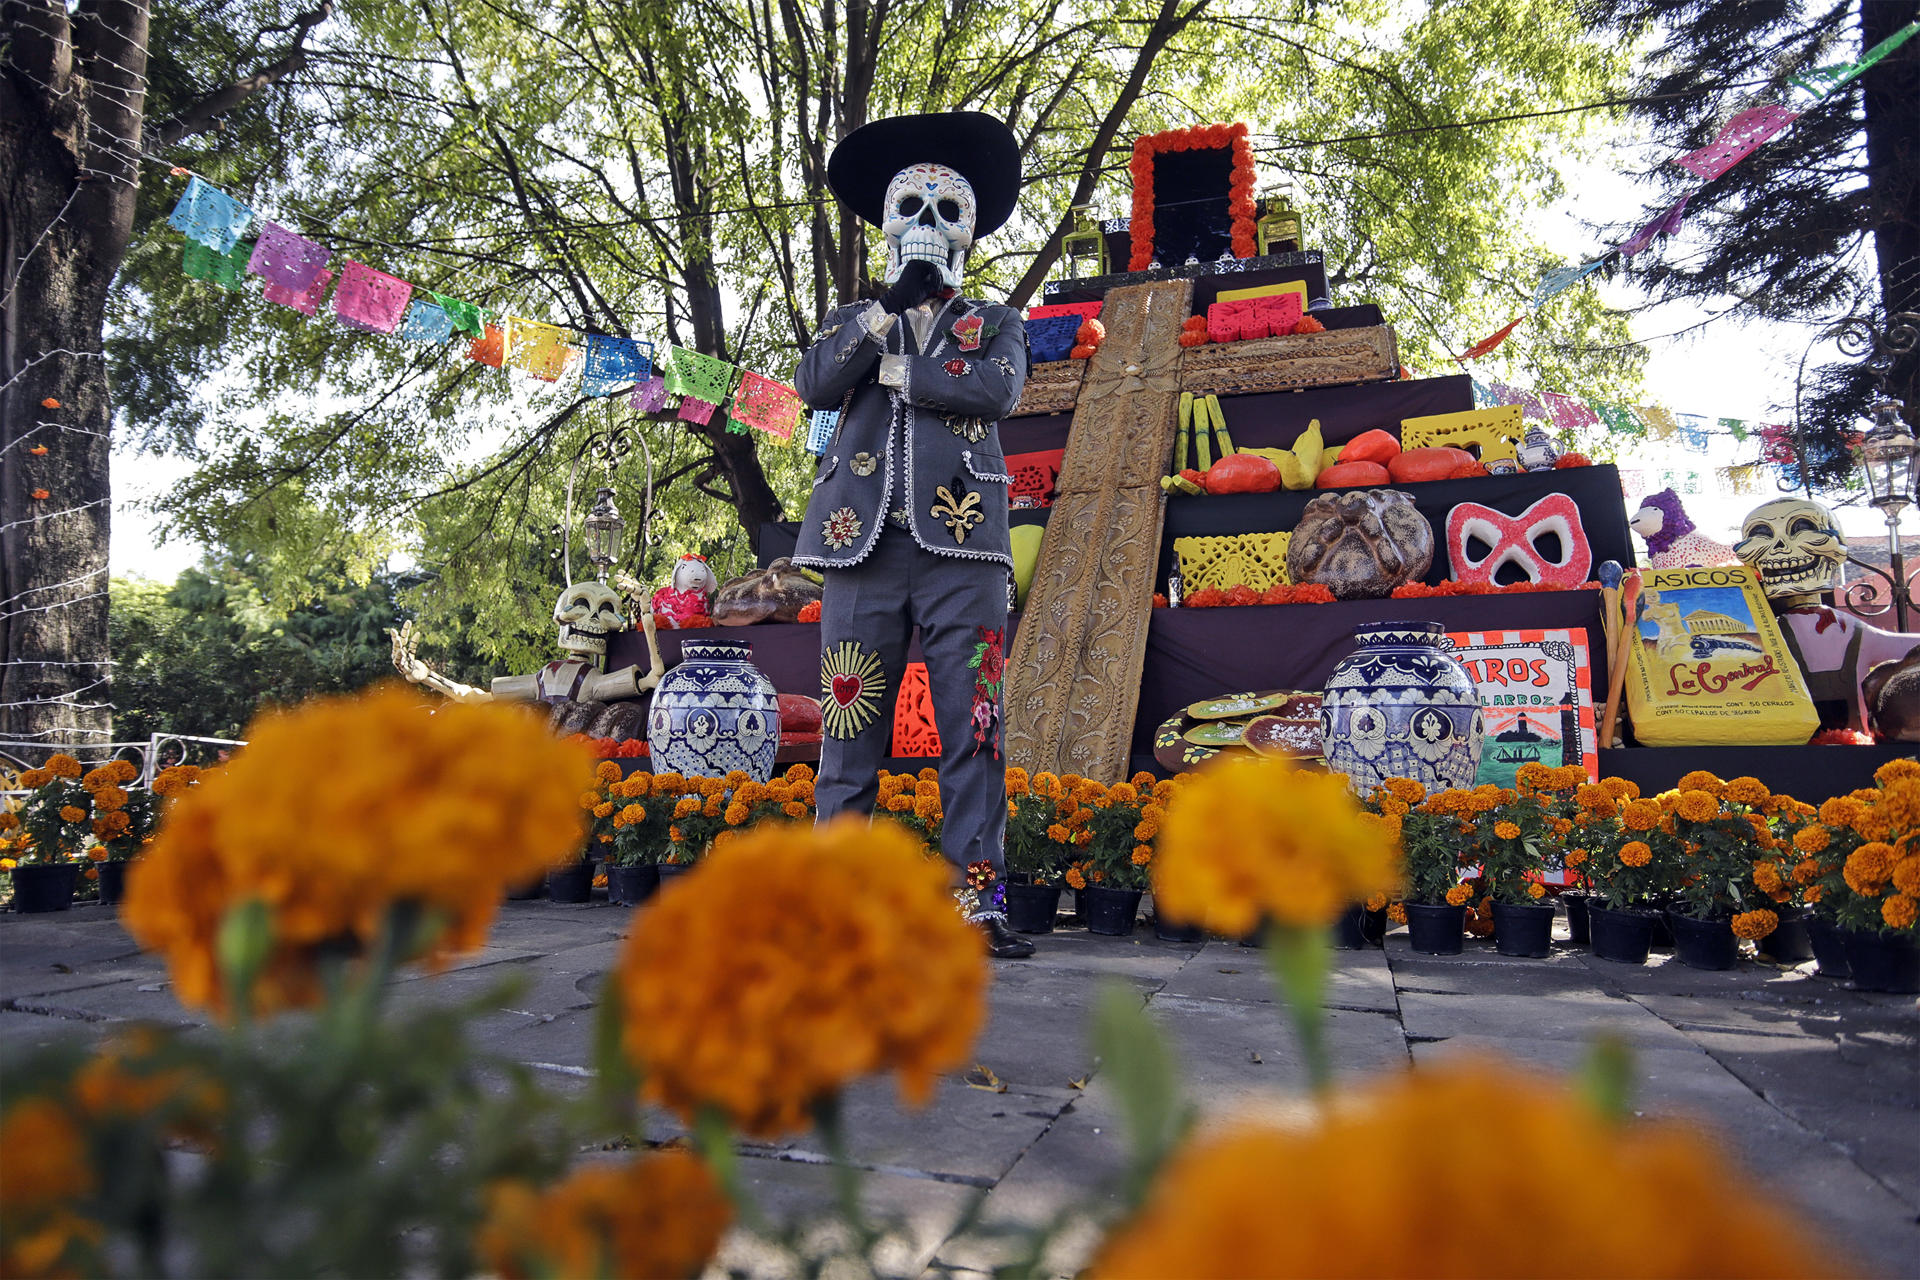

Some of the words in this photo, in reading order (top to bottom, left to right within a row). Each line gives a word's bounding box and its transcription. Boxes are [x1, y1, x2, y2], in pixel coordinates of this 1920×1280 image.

[1666, 663, 1701, 696] La
[1689, 655, 1781, 694] Central
[1493, 694, 1555, 706] ARROZ
